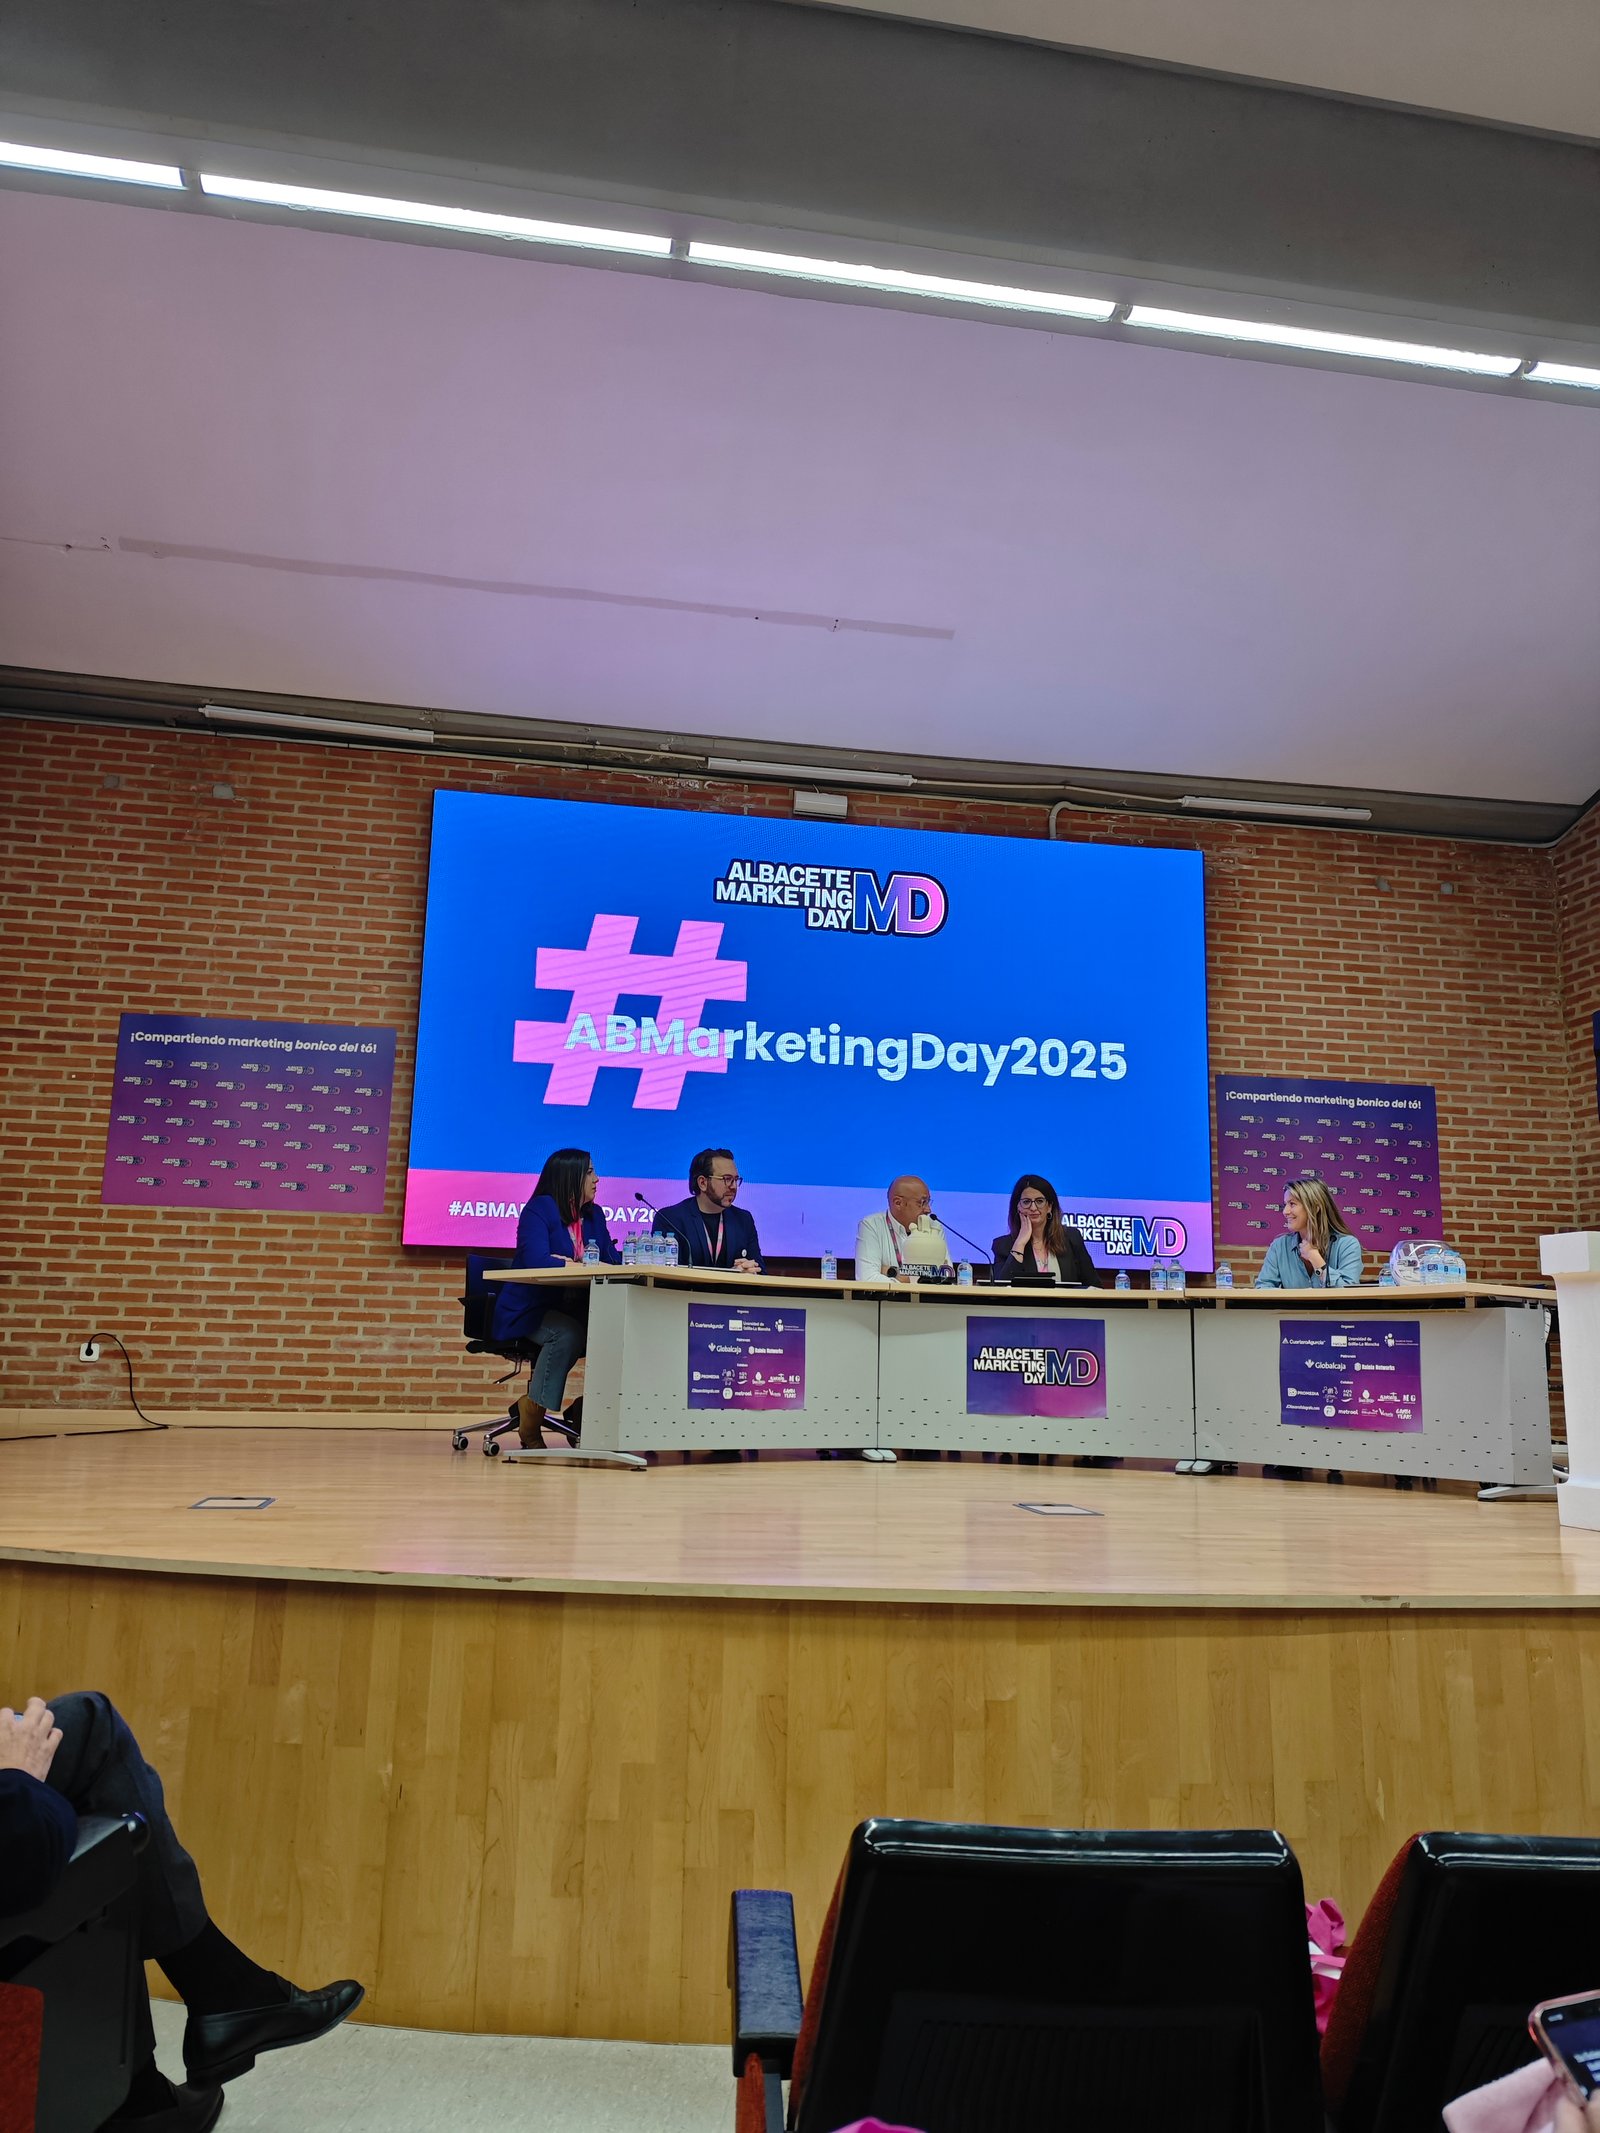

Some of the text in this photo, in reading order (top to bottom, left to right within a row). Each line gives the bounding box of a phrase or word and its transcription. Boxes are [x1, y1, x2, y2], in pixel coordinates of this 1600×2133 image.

[728, 861, 851, 889] ALBACETE
[716, 881, 853, 909] MARKETING
[852, 871, 945, 935] MD
[808, 908, 852, 929] DAY
[130, 1031, 377, 1054] ¡Compartiendo marketing bonico del tó!
[564, 1012, 1128, 1087] ABMarketingDay2025
[1226, 1091, 1422, 1109] ¡Compartiendo marketing bonico del tó!
[448, 1200, 526, 1218] #ABMA
[1061, 1214, 1131, 1229] ALBACETE
[1132, 1217, 1186, 1256] MD
[1106, 1241, 1132, 1254] DAY
[716, 1345, 742, 1354] Globalcaja
[979, 1347, 1044, 1361] ALBACETE
[973, 1359, 1046, 1372] MARKETING
[1045, 1349, 1099, 1386] MD
[1315, 1362, 1346, 1371] Globalcaja
[1024, 1372, 1045, 1384] DAY
